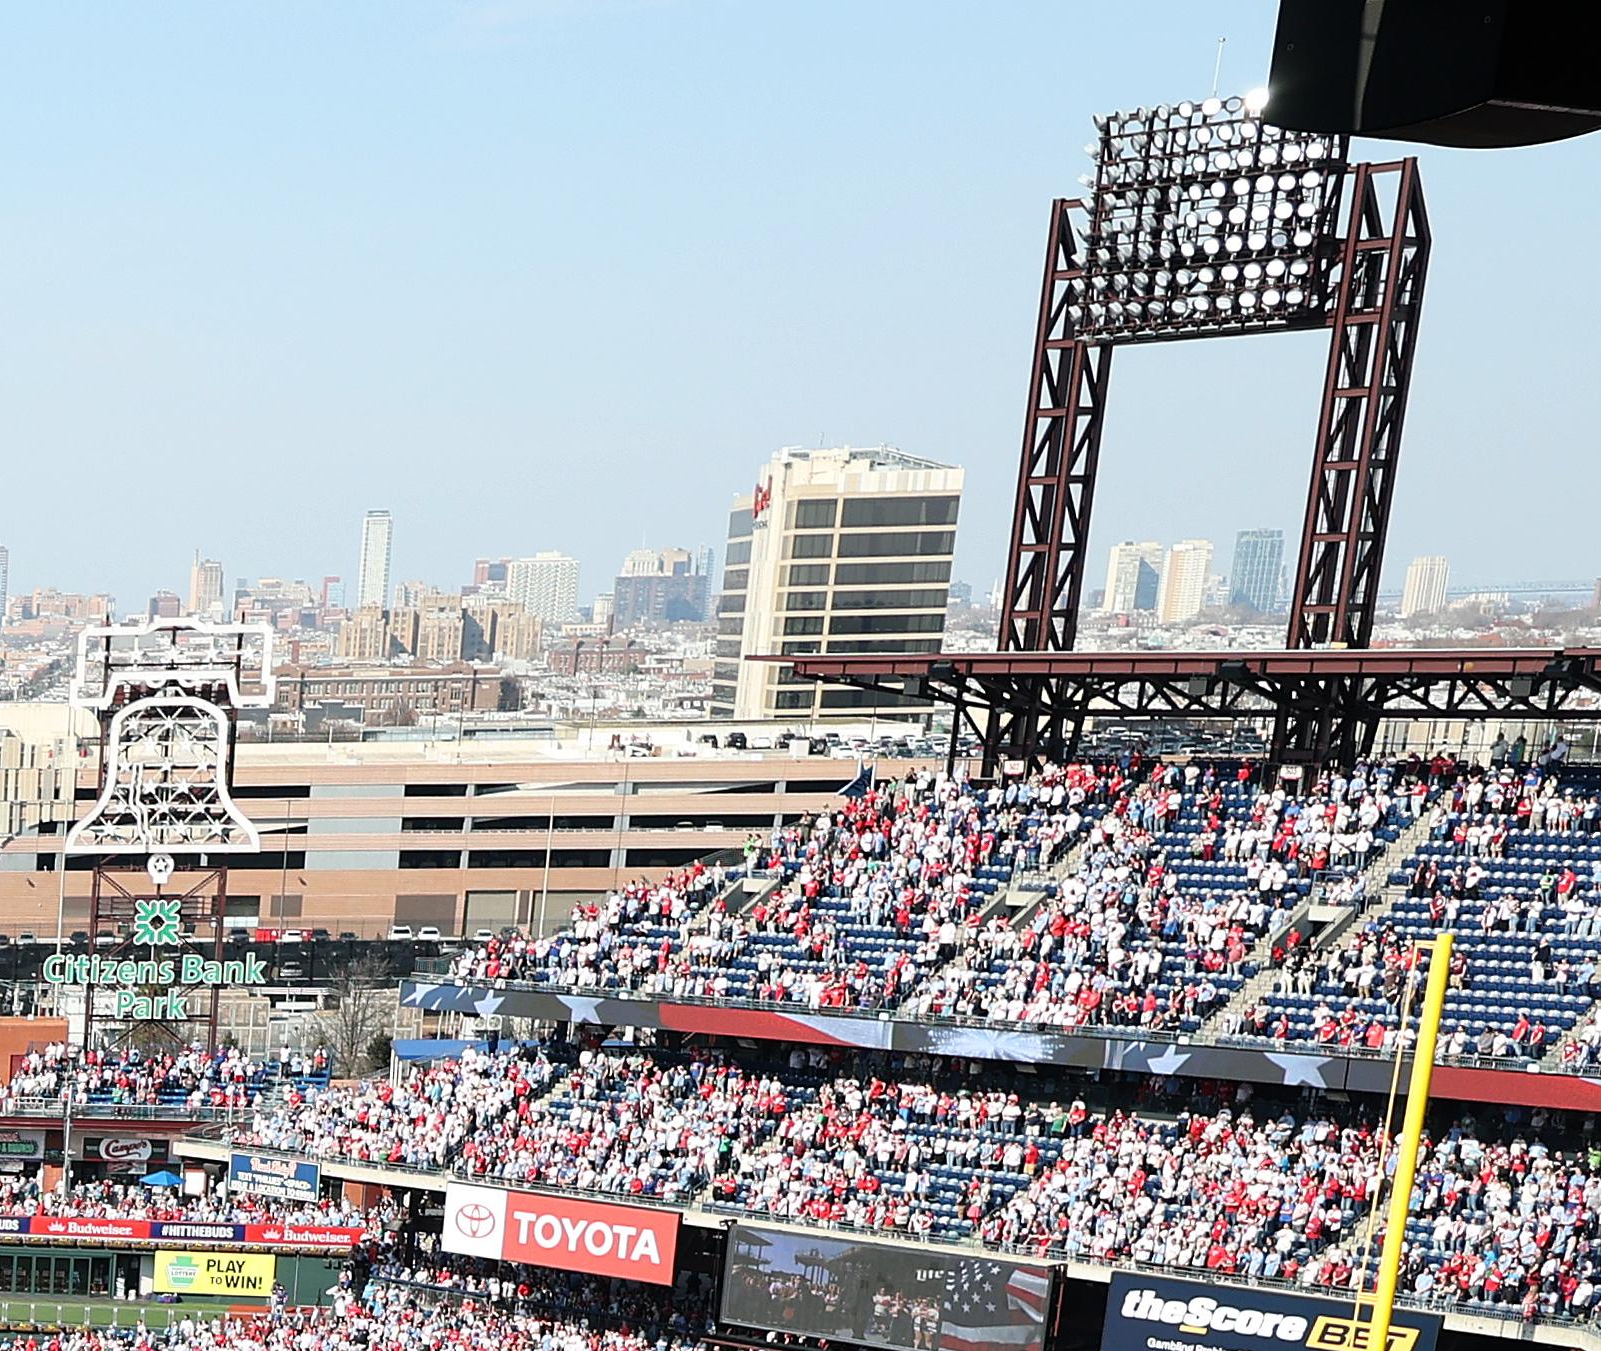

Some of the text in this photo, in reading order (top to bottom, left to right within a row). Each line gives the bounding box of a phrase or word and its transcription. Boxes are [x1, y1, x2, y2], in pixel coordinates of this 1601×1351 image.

[42, 951, 268, 985] Citizens Bank
[114, 988, 189, 1021] Park
[68, 1221, 133, 1237] Budweiser
[161, 1224, 234, 1239] #HITTHEBUDS
[282, 1229, 352, 1243] Budweiser
[514, 1209, 661, 1266] TOYOTA
[206, 1258, 246, 1273] PLAY
[210, 1275, 263, 1290] TO WIN!
[1119, 1288, 1308, 1343] theScore
